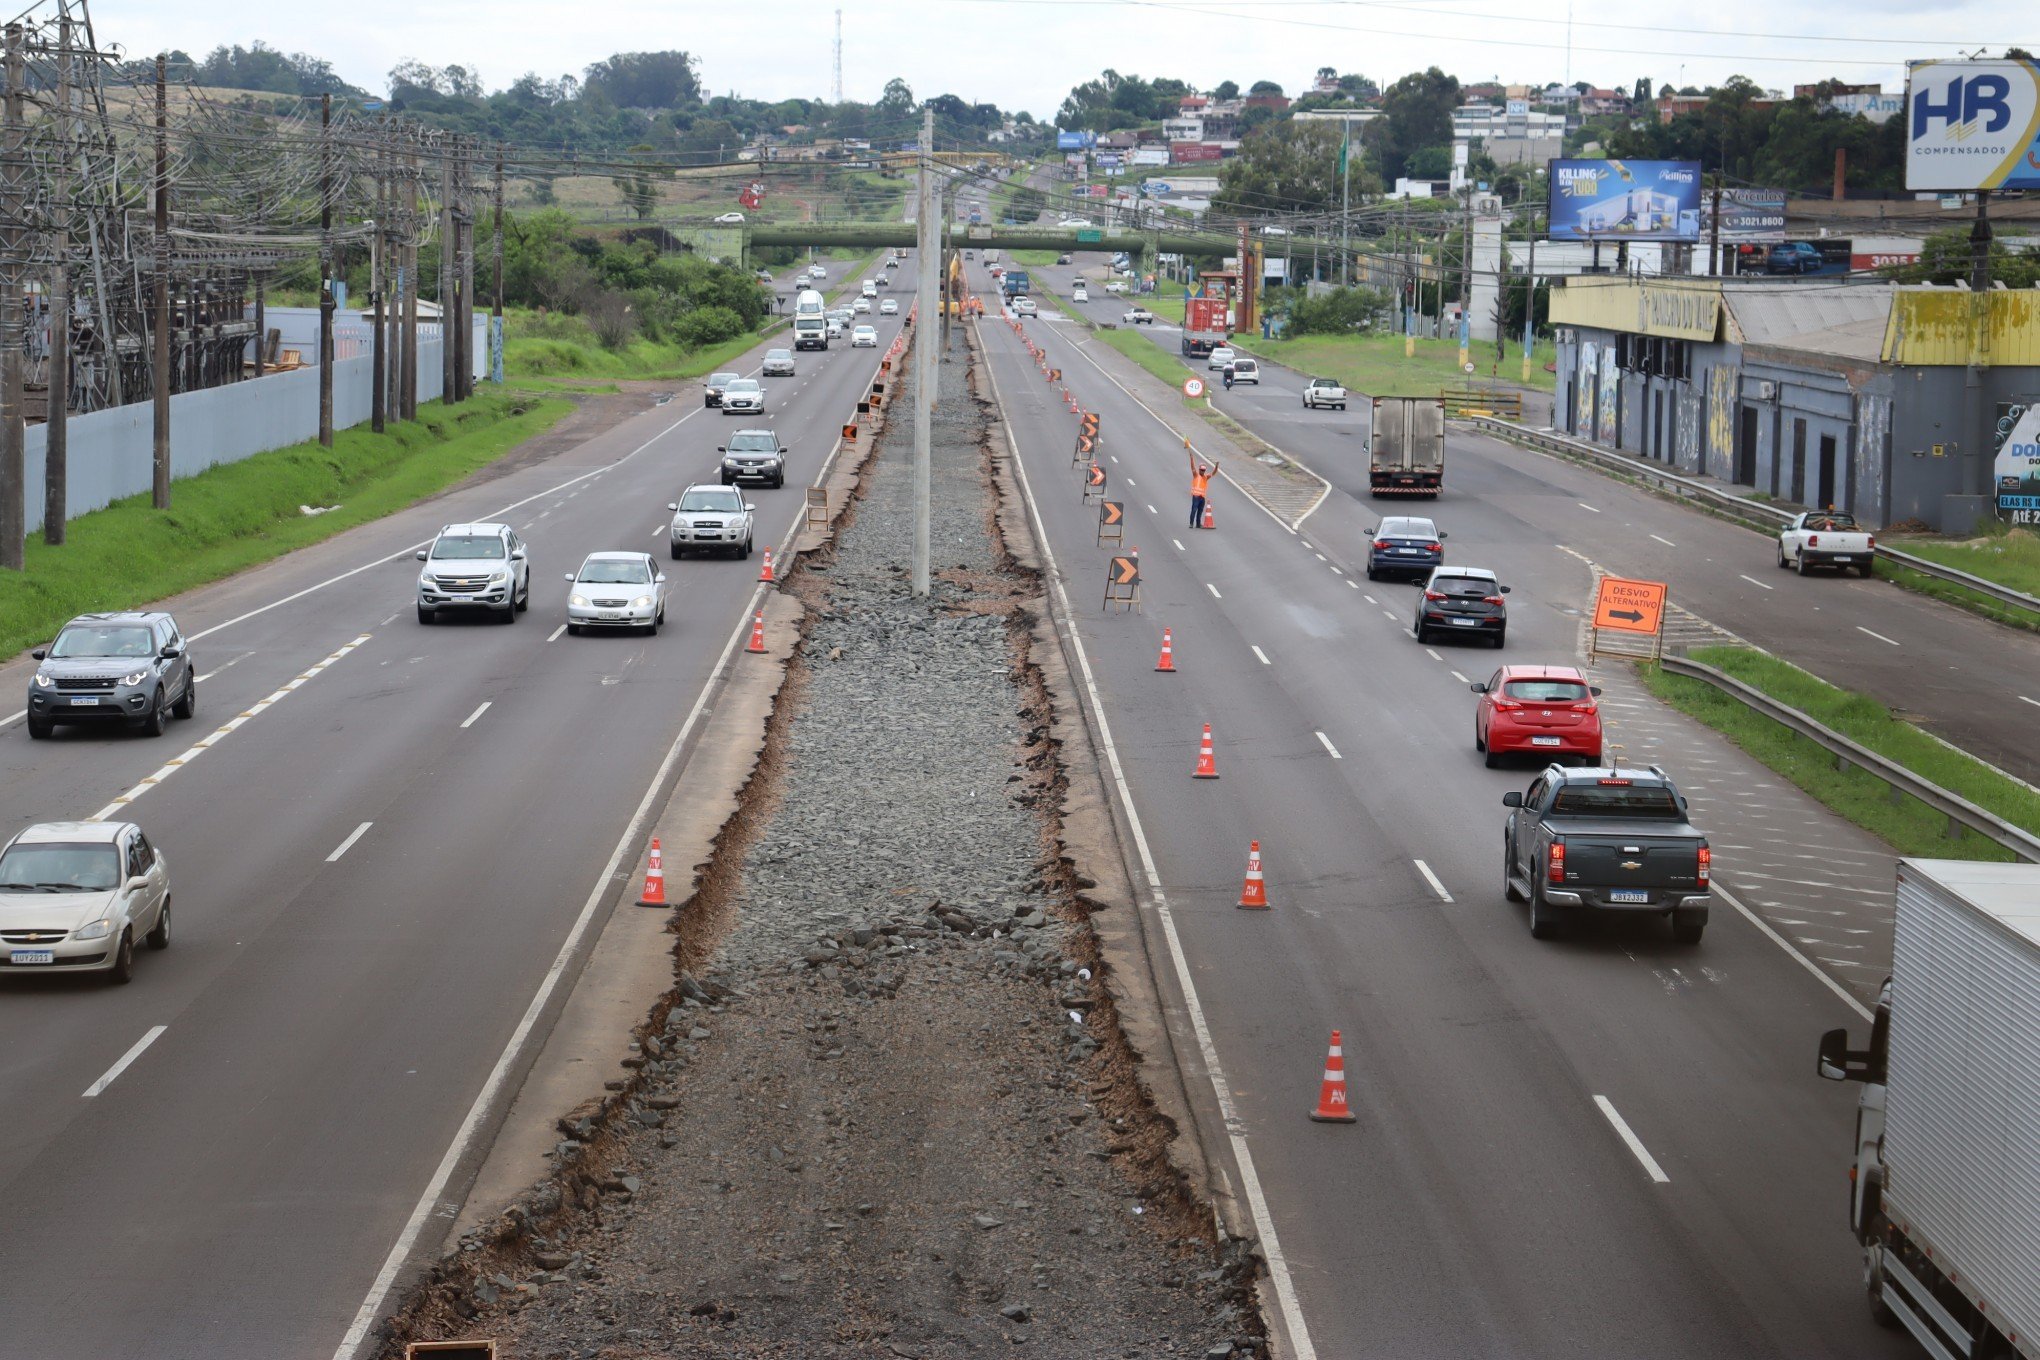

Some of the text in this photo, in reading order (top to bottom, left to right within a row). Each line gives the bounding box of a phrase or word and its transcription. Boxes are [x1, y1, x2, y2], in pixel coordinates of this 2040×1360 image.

[1510, 103, 1525, 113] NH
[1913, 74, 2011, 141] HB
[1915, 146, 2006, 155] COMPENSADOS
[1559, 168, 1597, 180] KILLING
[1740, 216, 1784, 226] 3021.8600
[1236, 278, 1244, 303] NOVO
[1189, 382, 1200, 390] 40
[2001, 496, 2020, 507] ELAS
[1613, 587, 1650, 598] DESVIO
[1603, 596, 1658, 609] ALTERNATIVO
[1330, 1089, 1346, 1104] AV
